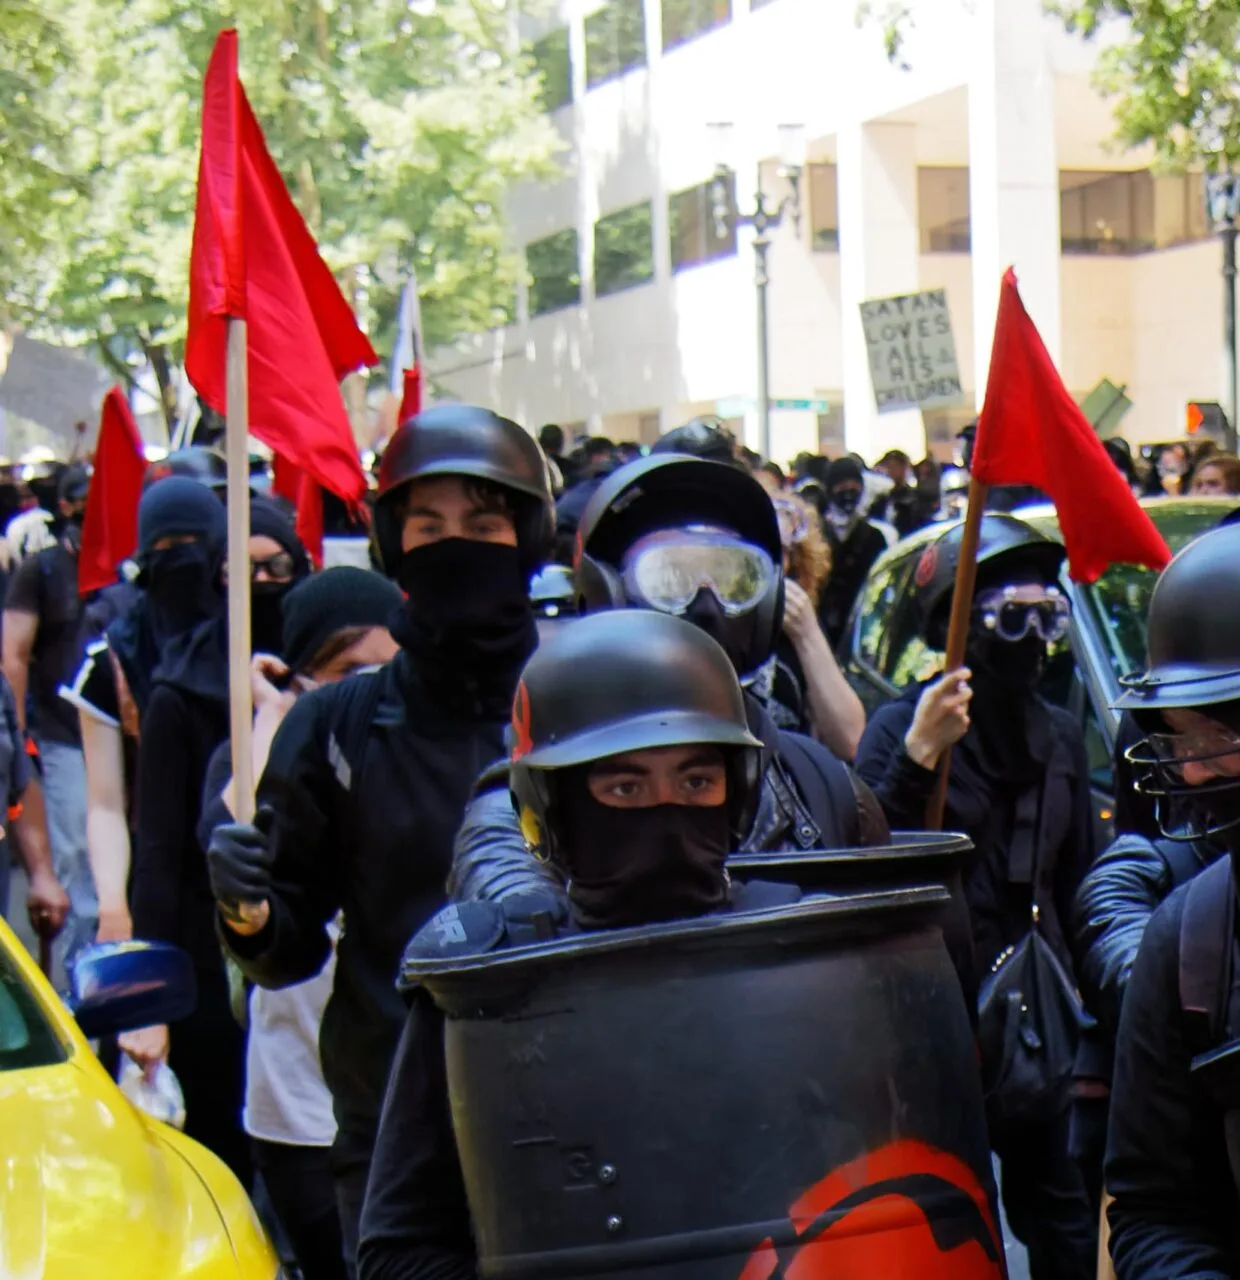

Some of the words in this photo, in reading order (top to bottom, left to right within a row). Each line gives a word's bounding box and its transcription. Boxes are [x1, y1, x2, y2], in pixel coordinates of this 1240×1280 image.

[862, 290, 946, 320] SATAN
[865, 314, 950, 345] LOVES
[887, 341, 932, 366] ALL
[889, 360, 934, 382] HIS
